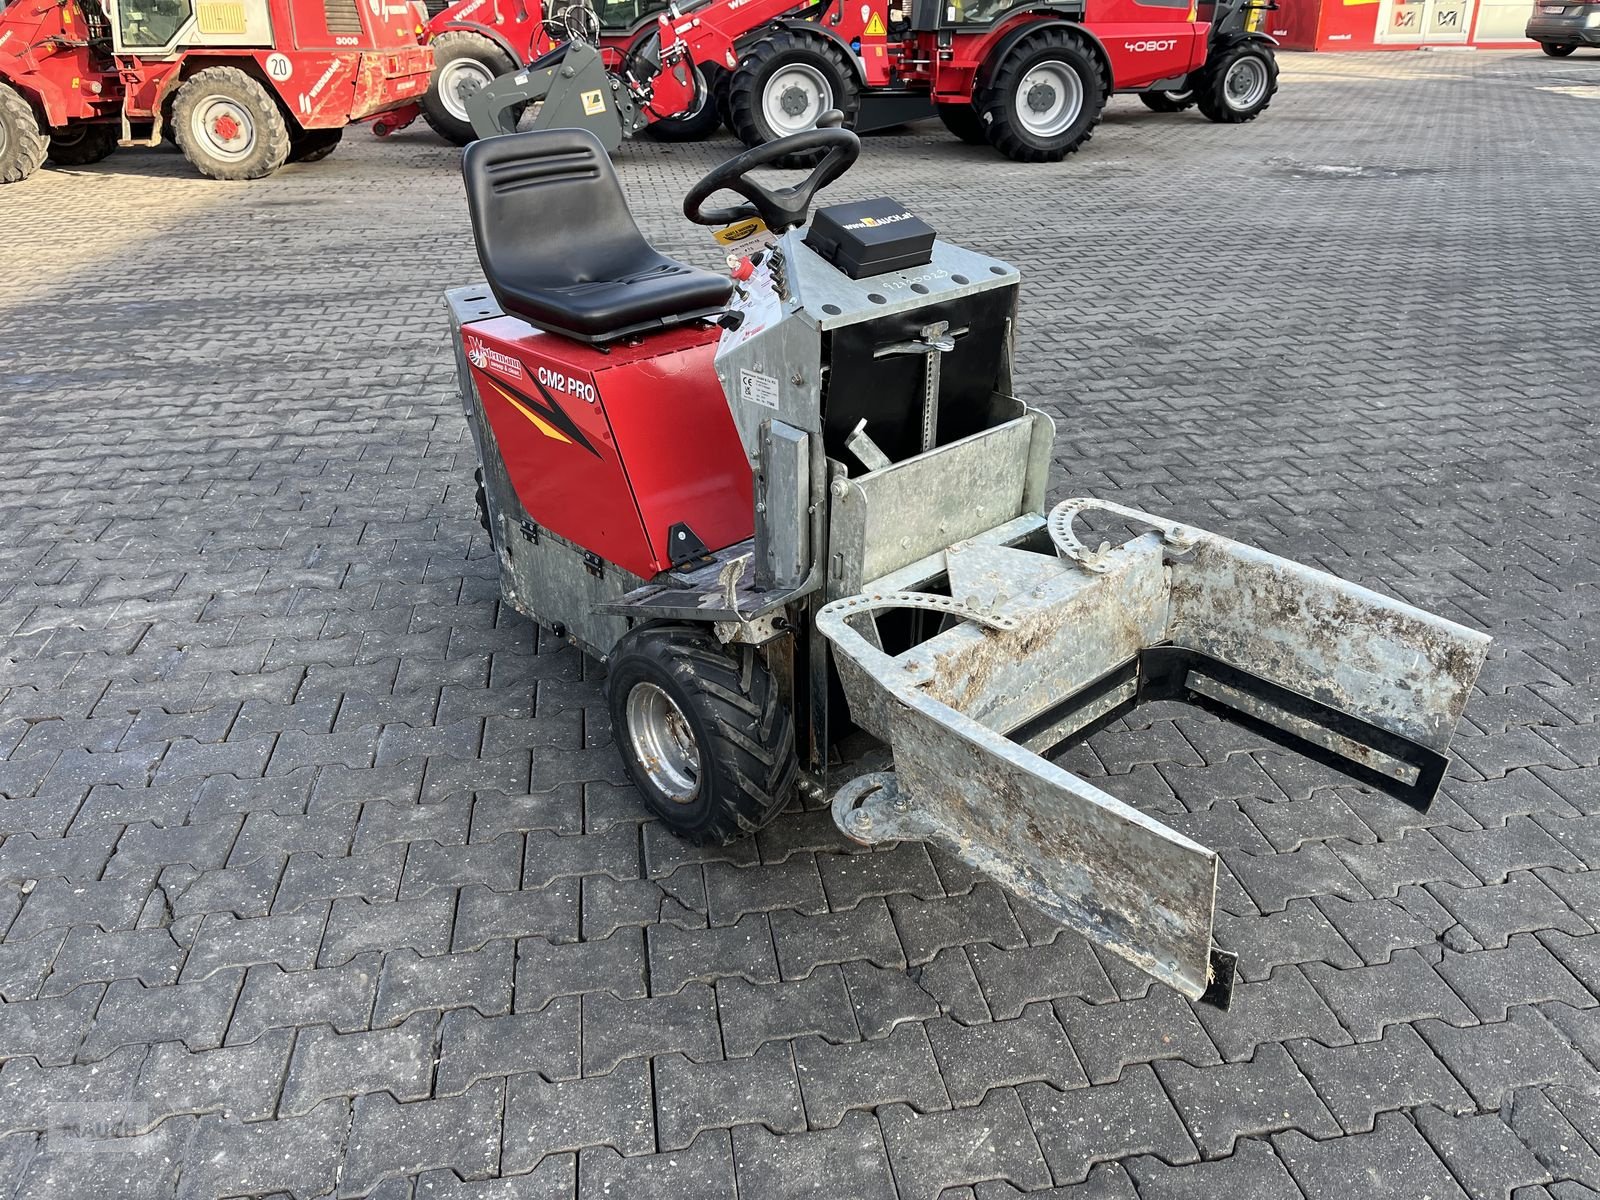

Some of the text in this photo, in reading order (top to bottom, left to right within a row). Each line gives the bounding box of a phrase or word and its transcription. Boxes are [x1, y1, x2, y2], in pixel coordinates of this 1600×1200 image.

[335, 37, 359, 45] 3006
[1124, 39, 1177, 52] 4080T
[271, 58, 287, 76] 20
[468, 335, 521, 369] Westermann
[538, 366, 596, 404] CM2 PRO
